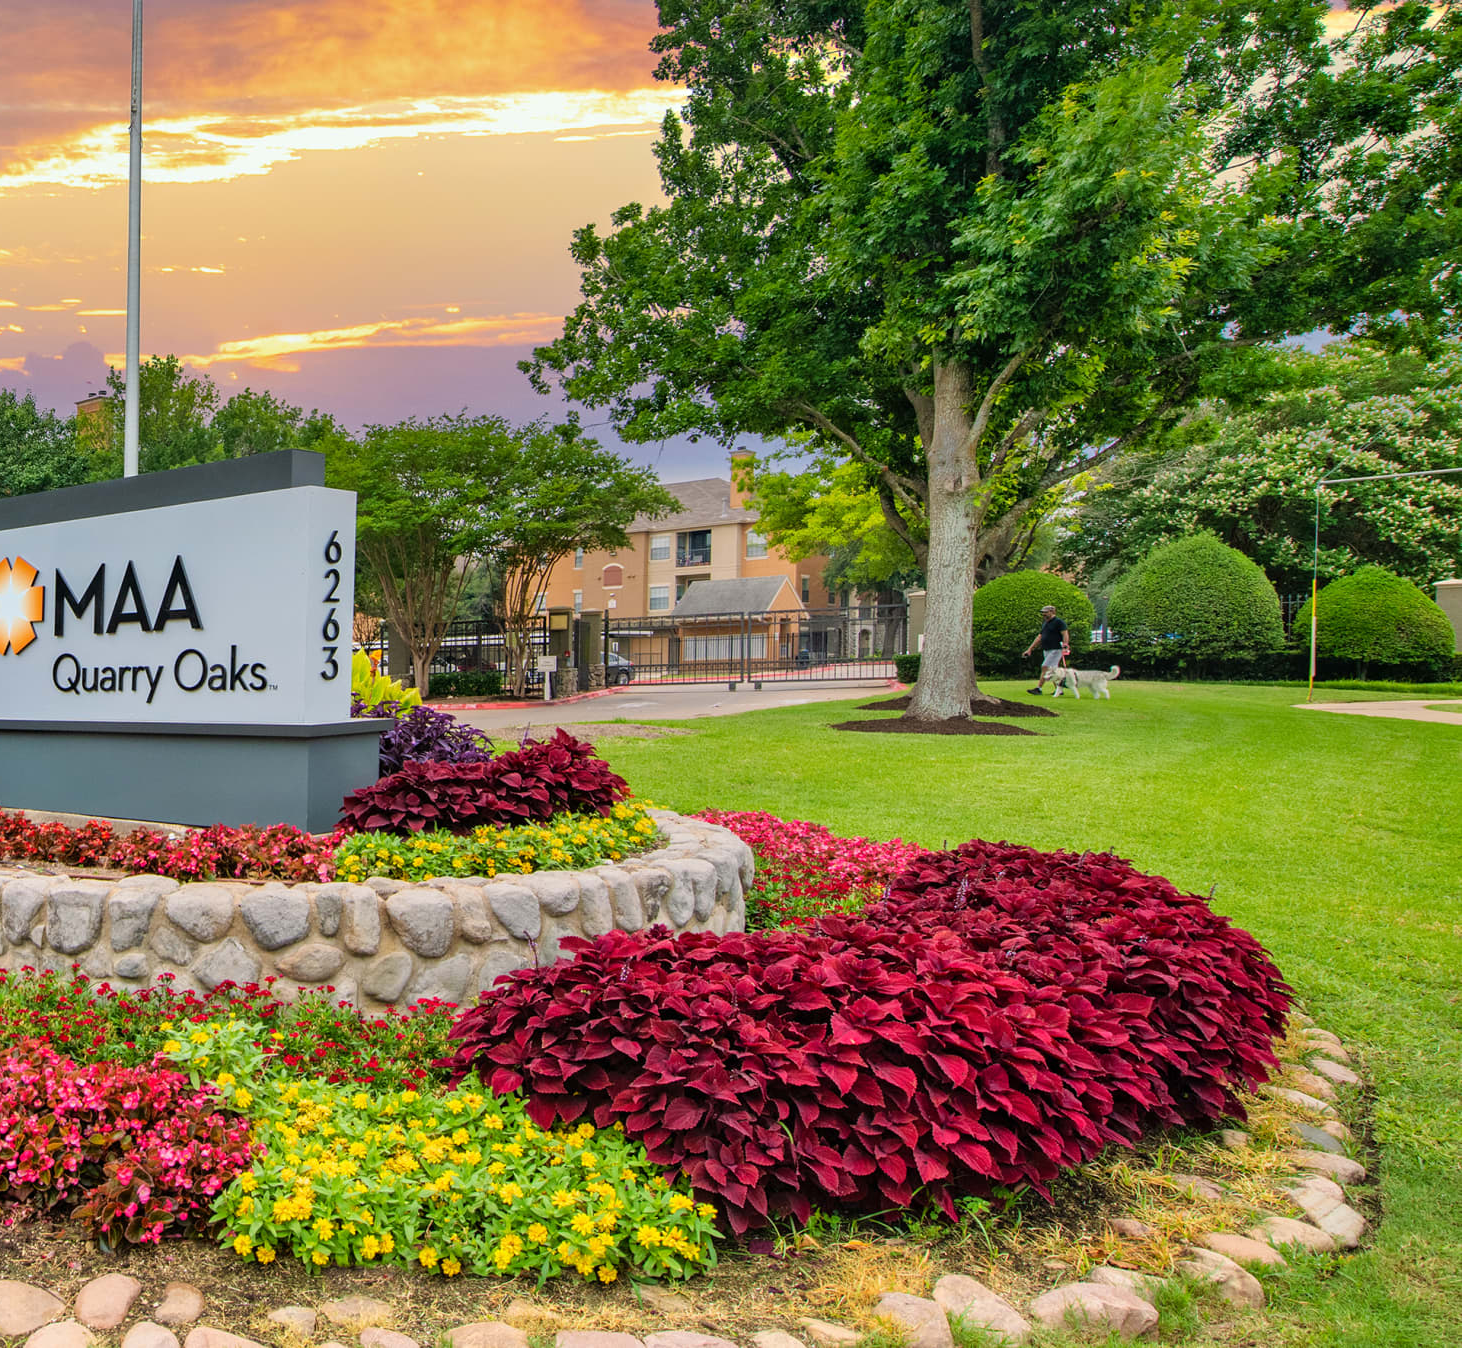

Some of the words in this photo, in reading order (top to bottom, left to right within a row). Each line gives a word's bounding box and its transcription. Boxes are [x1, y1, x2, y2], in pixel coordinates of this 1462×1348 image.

[53, 554, 205, 638] MAA
[320, 529, 343, 682] 6263
[52, 652, 165, 705] Quarry
